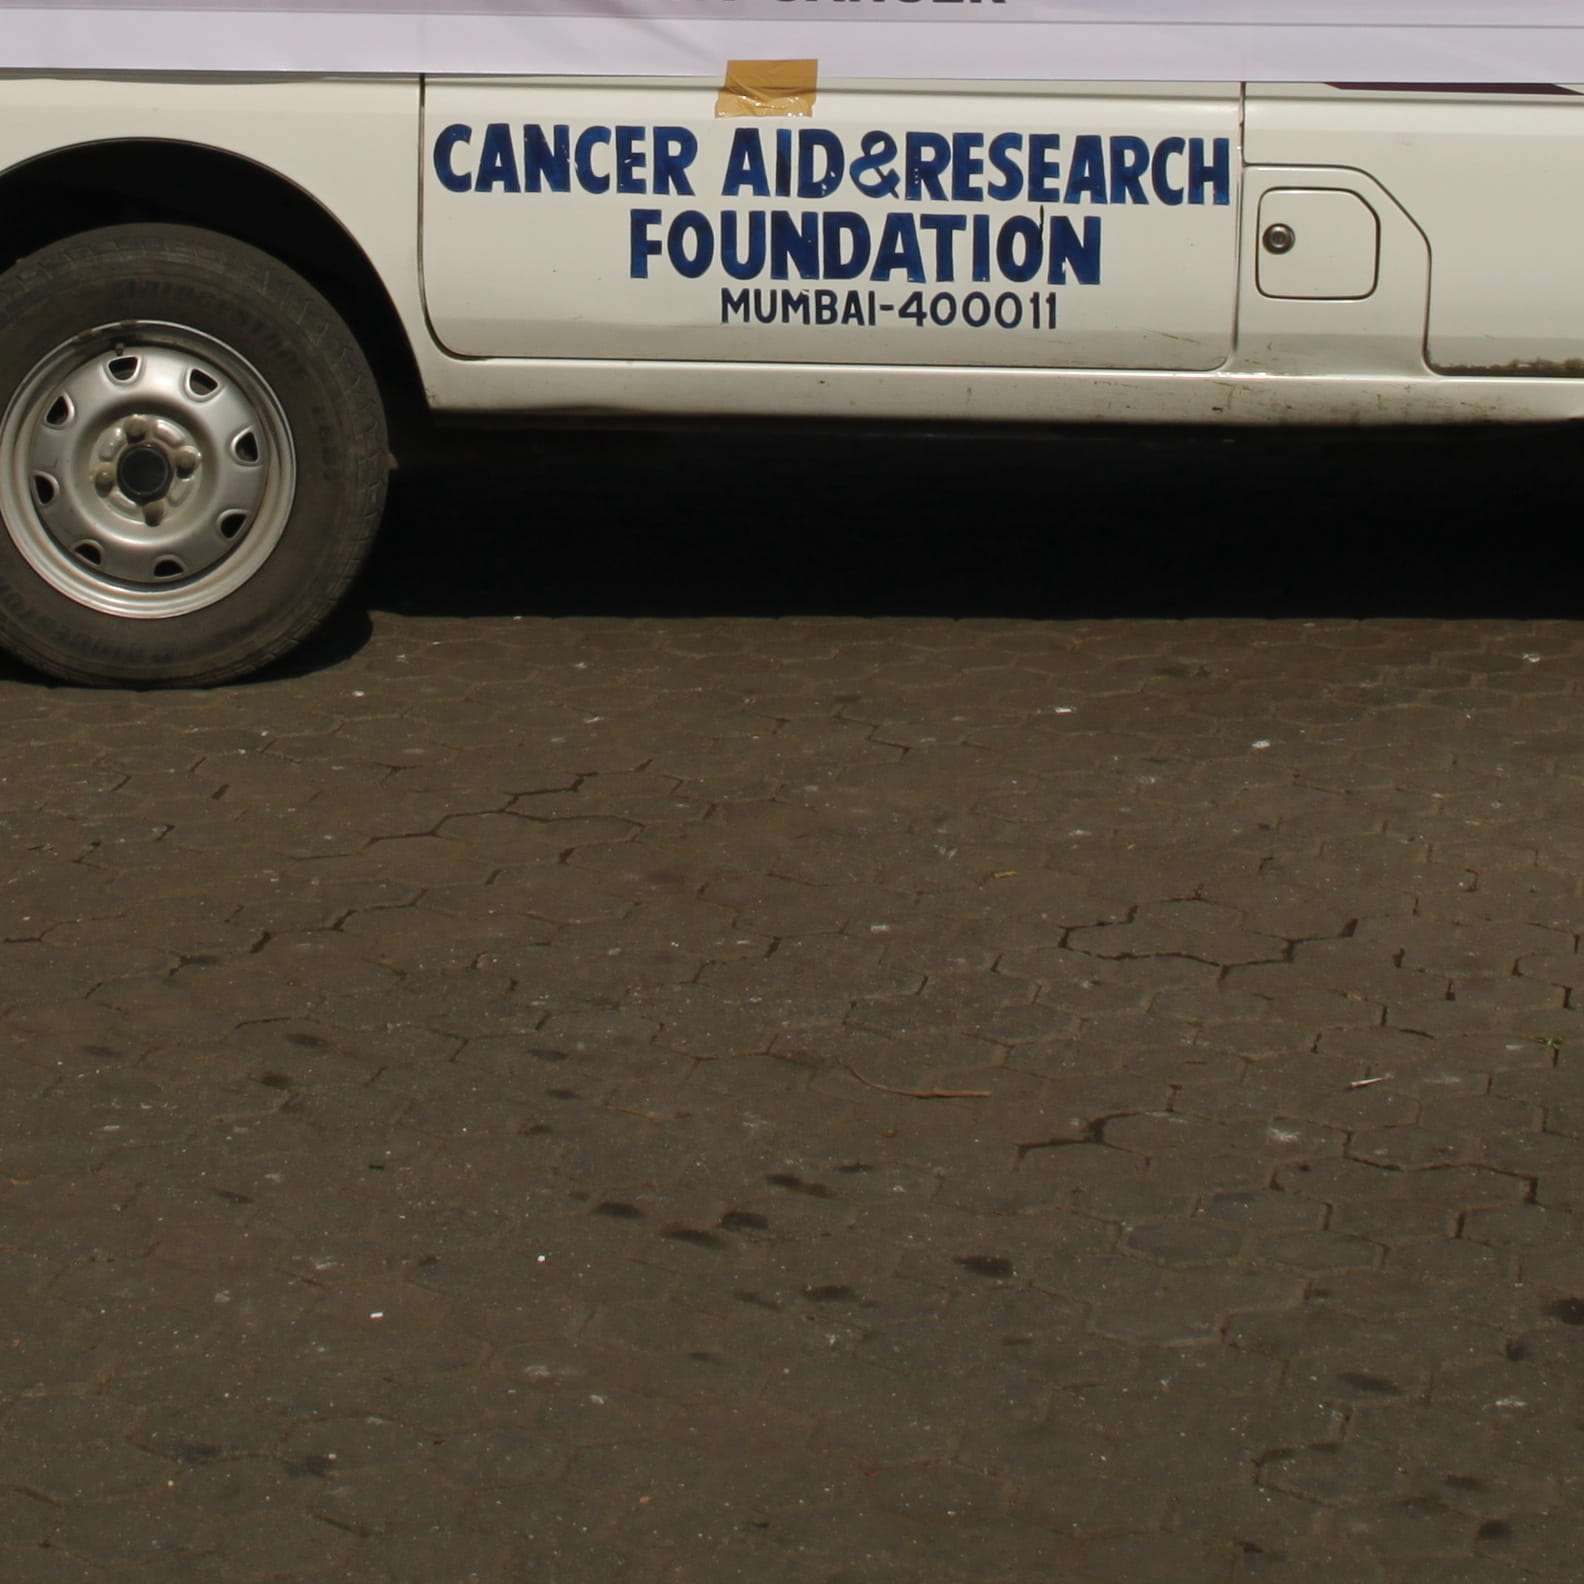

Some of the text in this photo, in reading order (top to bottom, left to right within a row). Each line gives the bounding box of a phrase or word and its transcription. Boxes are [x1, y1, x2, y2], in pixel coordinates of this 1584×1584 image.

[433, 123, 699, 198] CANCER
[630, 209, 1103, 287] FOUNDATION
[721, 288, 1058, 331] MUMBAI-400011
